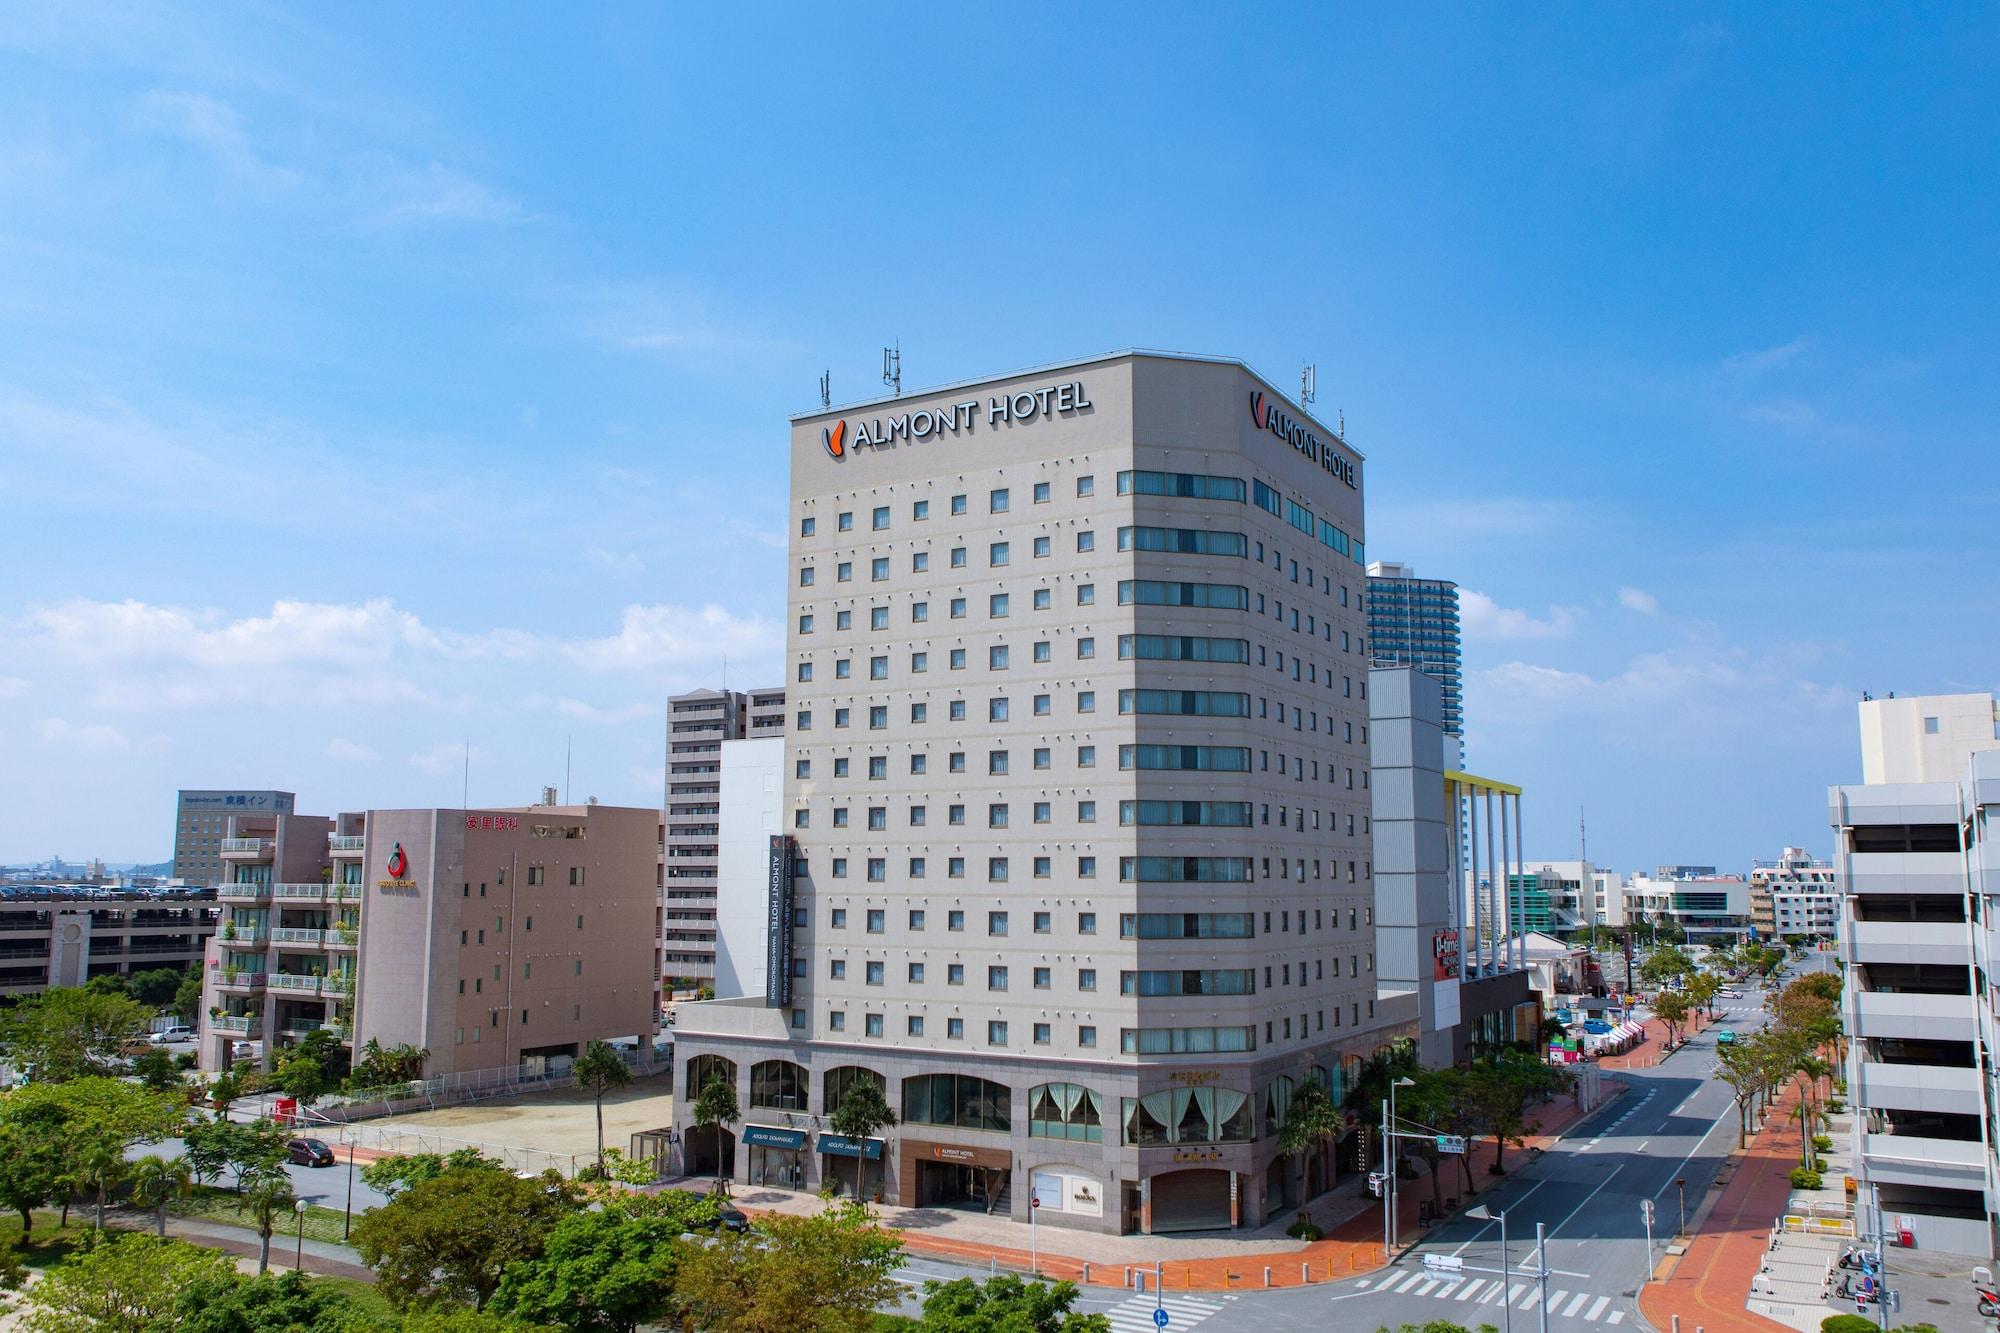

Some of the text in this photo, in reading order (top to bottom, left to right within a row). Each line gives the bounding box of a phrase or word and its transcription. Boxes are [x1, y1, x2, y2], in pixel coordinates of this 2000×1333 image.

[852, 381, 1091, 449] ALMONT HOTEL
[1266, 405, 1358, 490] ALMONT HOTEL
[225, 795, 268, 806] 東横イン
[466, 815, 518, 831] 安里眼科
[772, 855, 780, 898] ALMONT
[771, 900, 779, 932] HOTEL
